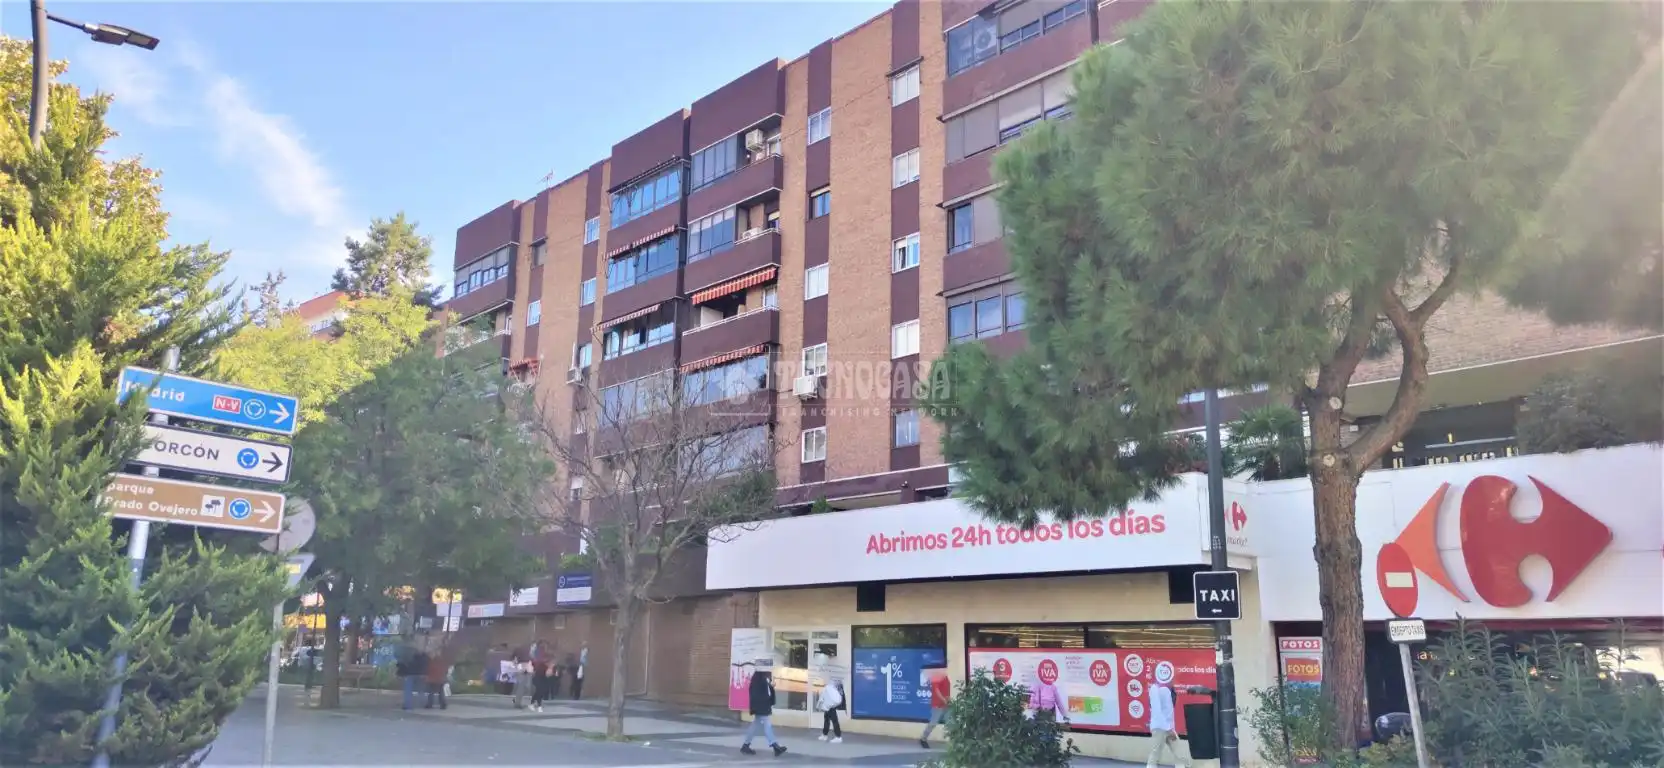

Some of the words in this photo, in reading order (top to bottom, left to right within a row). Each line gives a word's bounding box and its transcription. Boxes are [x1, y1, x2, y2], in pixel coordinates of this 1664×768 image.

[124, 380, 185, 402] Mdrid
[215, 397, 240, 411] N-V
[154, 440, 220, 461] ORCÓN
[106, 482, 155, 496] parque
[104, 495, 144, 511] Prado
[148, 501, 198, 516] Ovejero
[866, 529, 947, 554] Abrimos
[951, 525, 992, 549] 24h
[996, 522, 1063, 545] todos
[1067, 519, 1104, 542] los
[1109, 510, 1166, 536] días
[1199, 588, 1236, 602] TAXI
[1282, 640, 1320, 649] FOTOS
[1040, 668, 1056, 677] IVA
[1092, 669, 1108, 678] IVA
[1287, 663, 1321, 675] FOTOS
